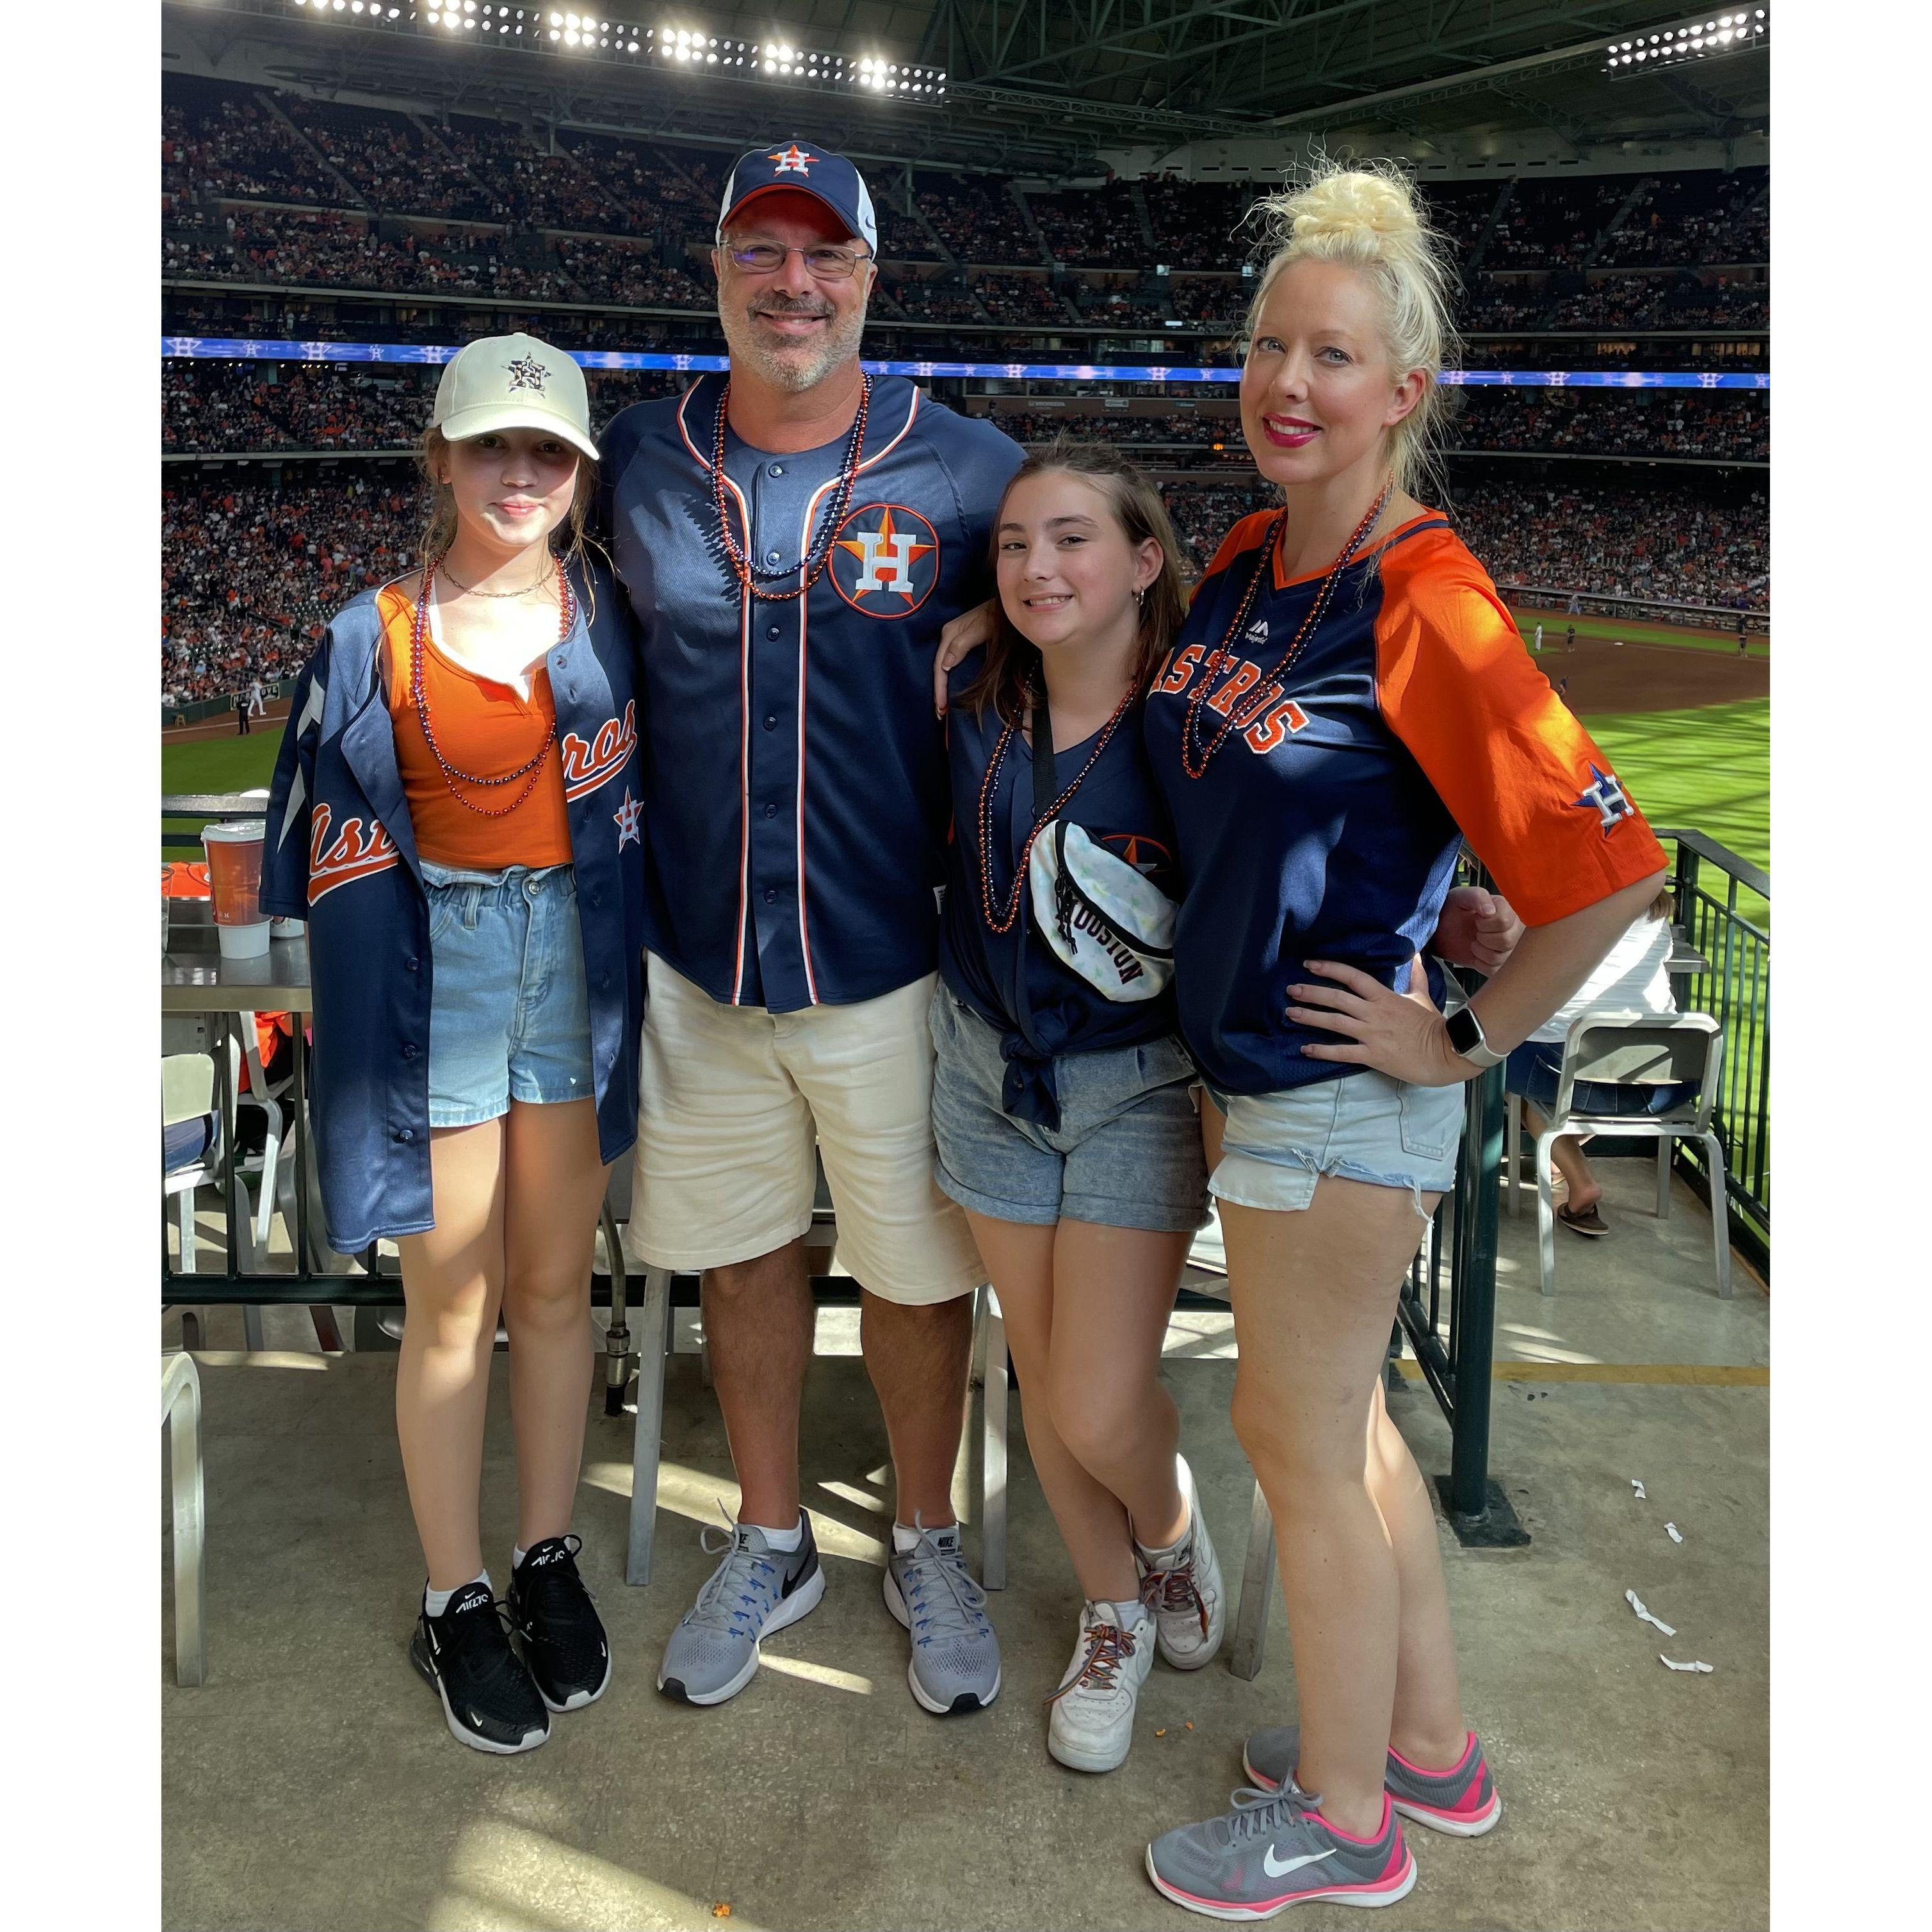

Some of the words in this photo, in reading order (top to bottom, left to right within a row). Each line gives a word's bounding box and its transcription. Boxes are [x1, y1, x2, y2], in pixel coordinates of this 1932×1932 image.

[775, 150, 810, 172] H
[855, 532, 916, 593] H
[1581, 774, 1634, 827] H
[938, 1536, 955, 1548] NIKE
